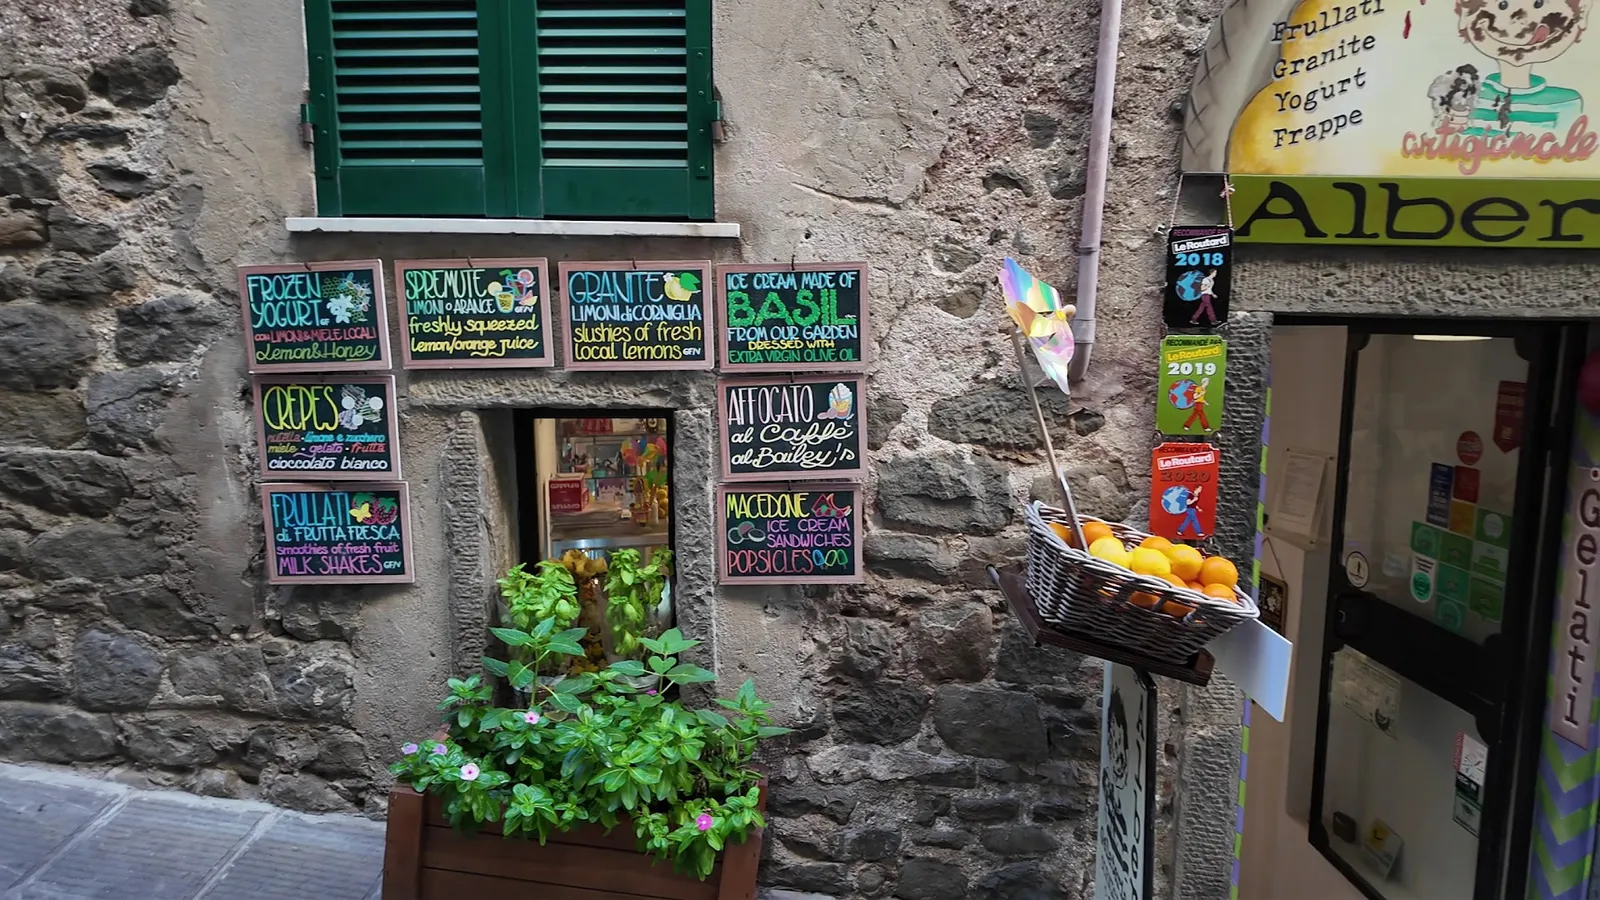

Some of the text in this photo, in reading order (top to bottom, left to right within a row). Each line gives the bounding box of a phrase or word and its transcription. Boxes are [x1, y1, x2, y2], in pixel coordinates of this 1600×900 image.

[1271, 0, 1385, 42] Frullati
[1273, 34, 1376, 79] Granite
[1275, 67, 1367, 112] Yogurt
[1273, 109, 1364, 148] Frappe
[1234, 181, 1600, 243] Alber
[1174, 252, 1224, 266] 2018
[247, 272, 322, 302] FROZEN
[405, 269, 487, 300] SPREMUTE
[569, 271, 664, 303] GRANITE
[727, 271, 858, 290] ICE CREAM MADE OF
[251, 300, 322, 328] YOGURT
[407, 299, 444, 315] LIMONI
[453, 299, 496, 314] ARANCE
[571, 304, 620, 321] LIMONI
[632, 304, 702, 321] CORNIGLIA
[727, 288, 857, 327] BASIL
[408, 314, 539, 336] freshly squeezed
[573, 321, 702, 343] slushies of fresh
[727, 324, 858, 342] FROM OUR GARDEN
[574, 342, 618, 360] local
[622, 341, 683, 360] lemons
[748, 339, 835, 351] DRESSED WITH
[729, 348, 859, 363] EXTRA VIRGIN OLIVE OIL
[1167, 362, 1217, 375] 2019
[728, 385, 814, 425] AFFOGATO
[731, 427, 754, 444] al
[267, 442, 387, 458] miele gelato frutta
[731, 443, 855, 469] al Bailey's
[268, 456, 388, 470] cioccolato bianco
[1160, 470, 1211, 483] 2020
[271, 492, 351, 527] FRULLATI
[276, 525, 400, 542] di FRUTTA FRESCA
[767, 519, 850, 533] ICE CREAM
[276, 541, 400, 555] smoothies of fresh fruit
[767, 533, 851, 548] SANDWICHES
[278, 556, 315, 575] MILK
[319, 555, 384, 574] SHAKES
[729, 549, 814, 574] POPSICLES
[1563, 488, 1600, 727] Gelati
